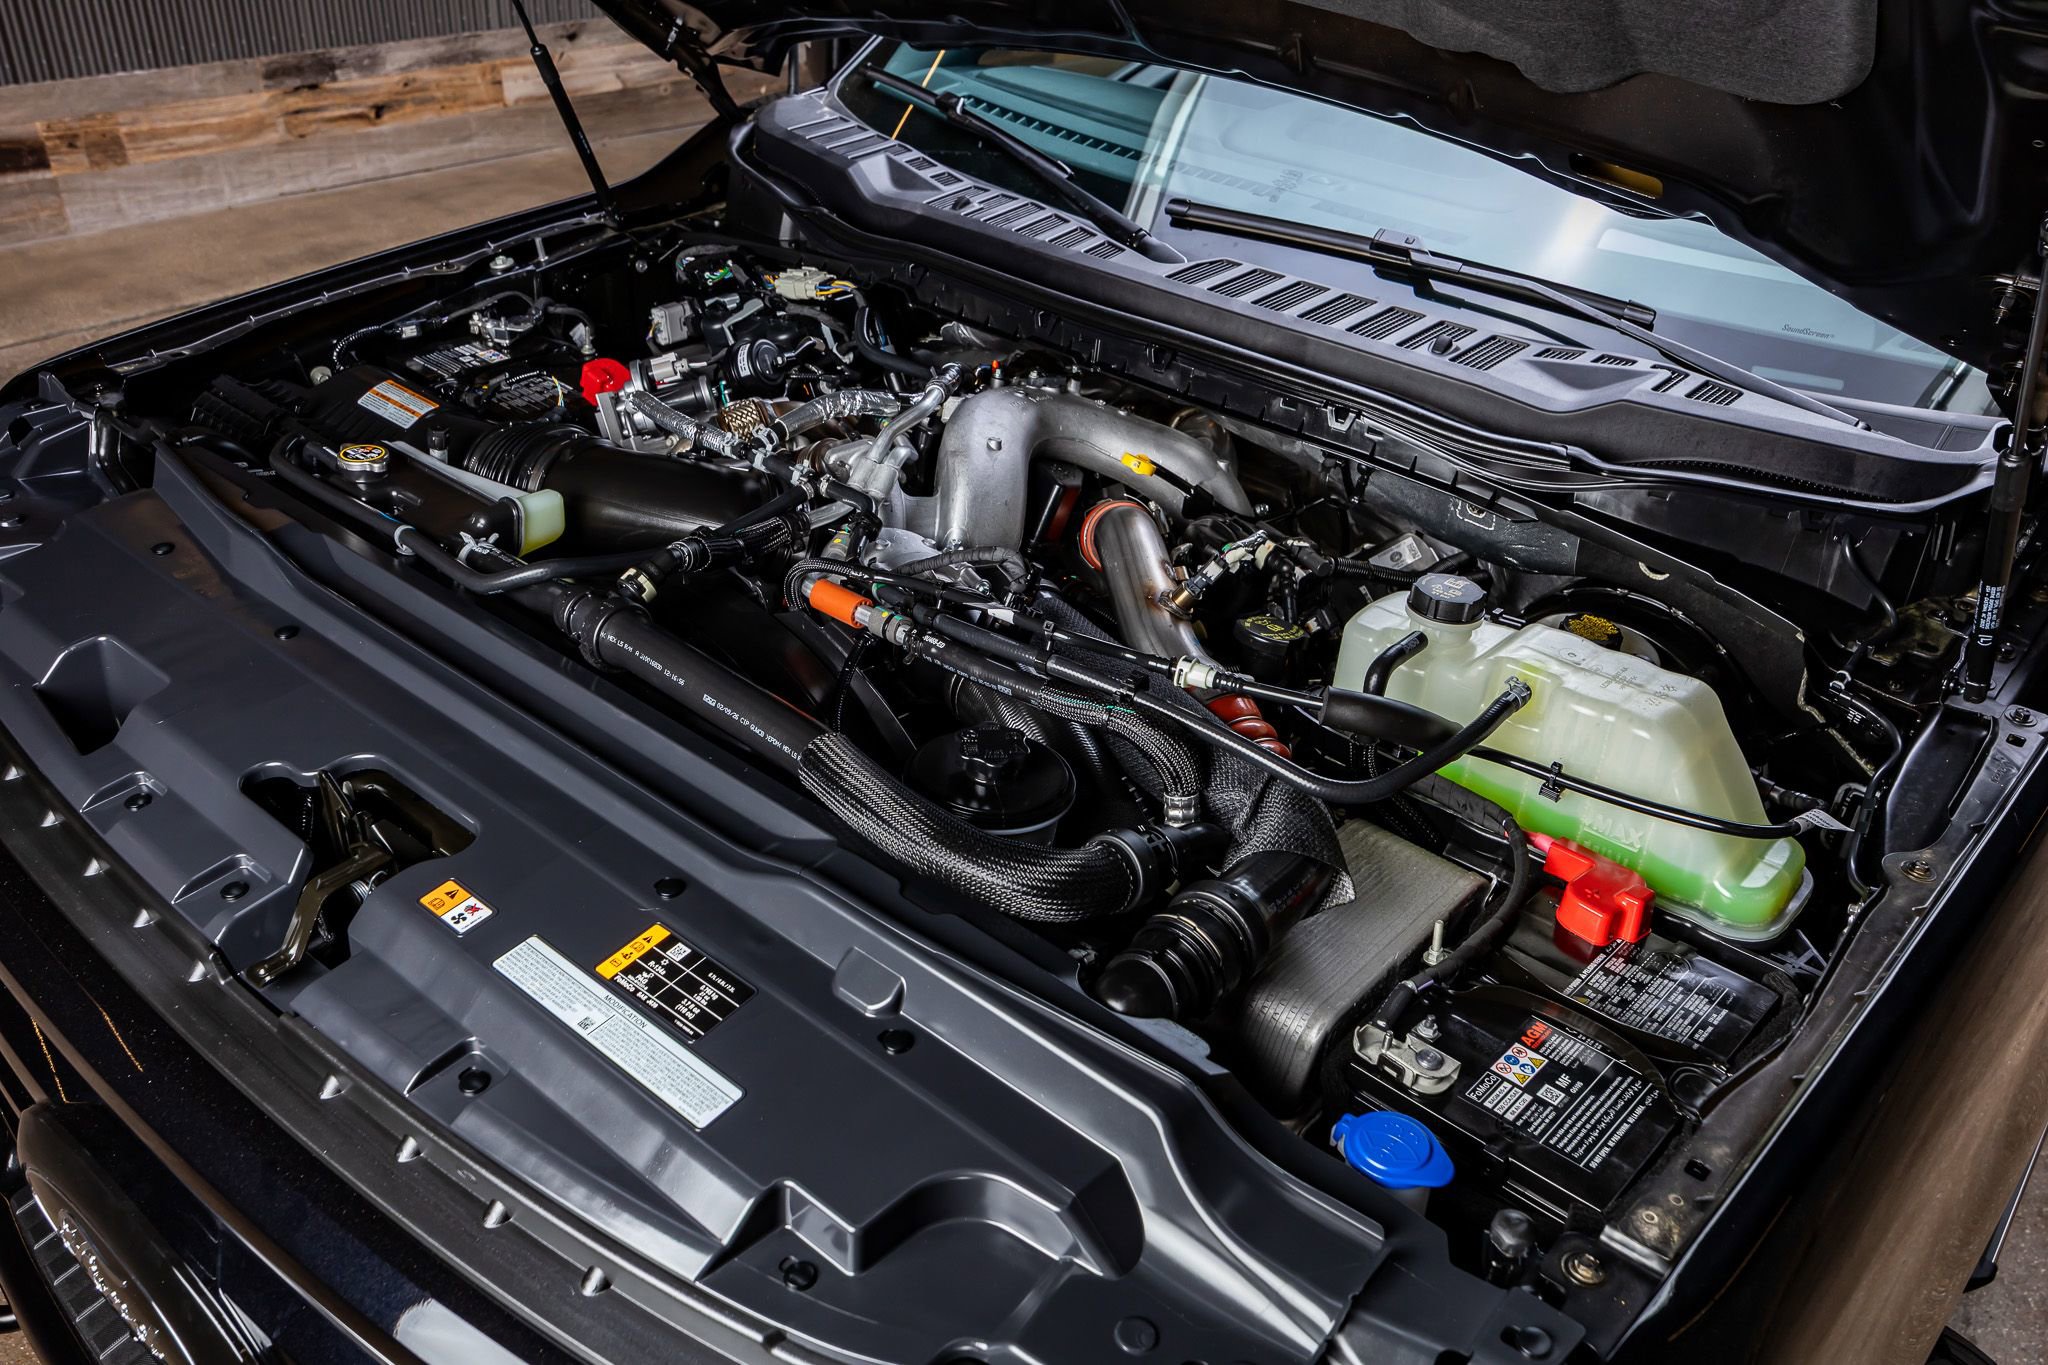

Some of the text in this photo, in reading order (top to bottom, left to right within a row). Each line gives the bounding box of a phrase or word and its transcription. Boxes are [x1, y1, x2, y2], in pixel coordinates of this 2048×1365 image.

[614, 975, 635, 991] FoMoCo
[604, 994, 647, 1028] MODIFICATION
[1521, 1021, 1547, 1046] AGM
[1471, 1075, 1496, 1101] FoMoCo
[1555, 1073, 1571, 1088] MF
